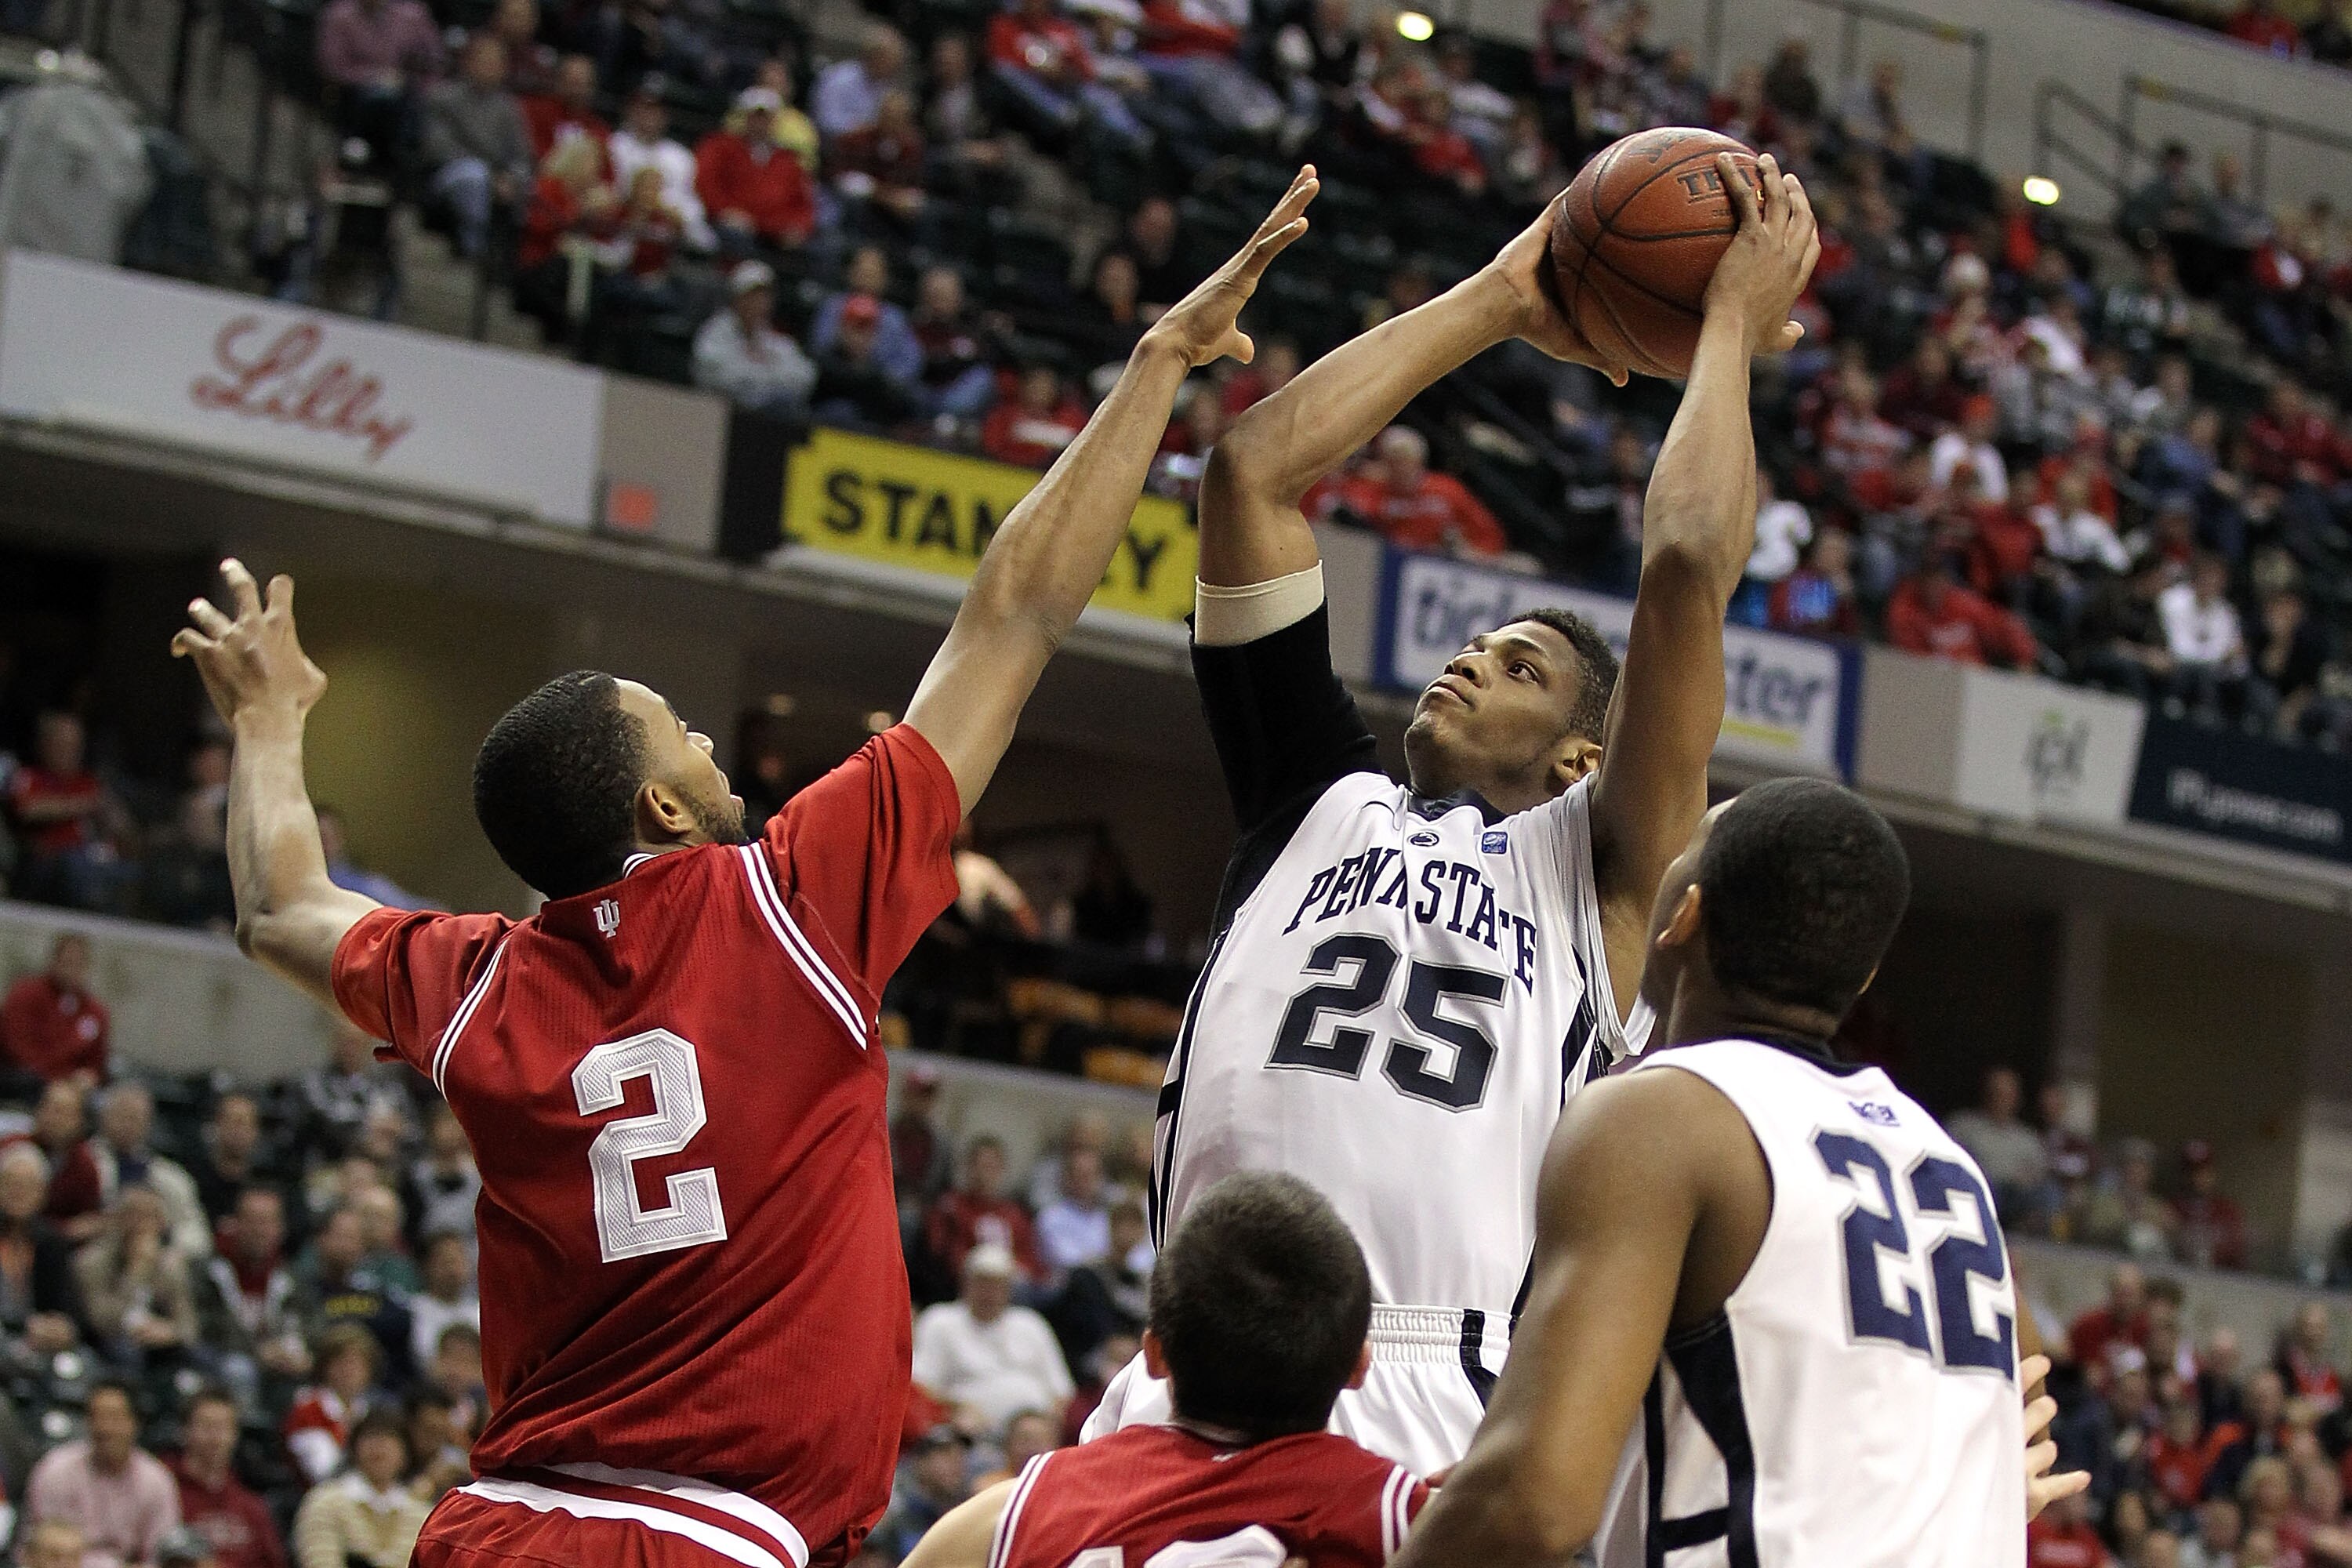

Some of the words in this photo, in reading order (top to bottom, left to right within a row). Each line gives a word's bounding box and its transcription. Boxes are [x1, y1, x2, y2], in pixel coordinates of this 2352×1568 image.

[190, 316, 412, 461] Lilly
[1263, 931, 1511, 1114] 25
[571, 1027, 728, 1264] 2
[1806, 1123, 2016, 1381] 22
